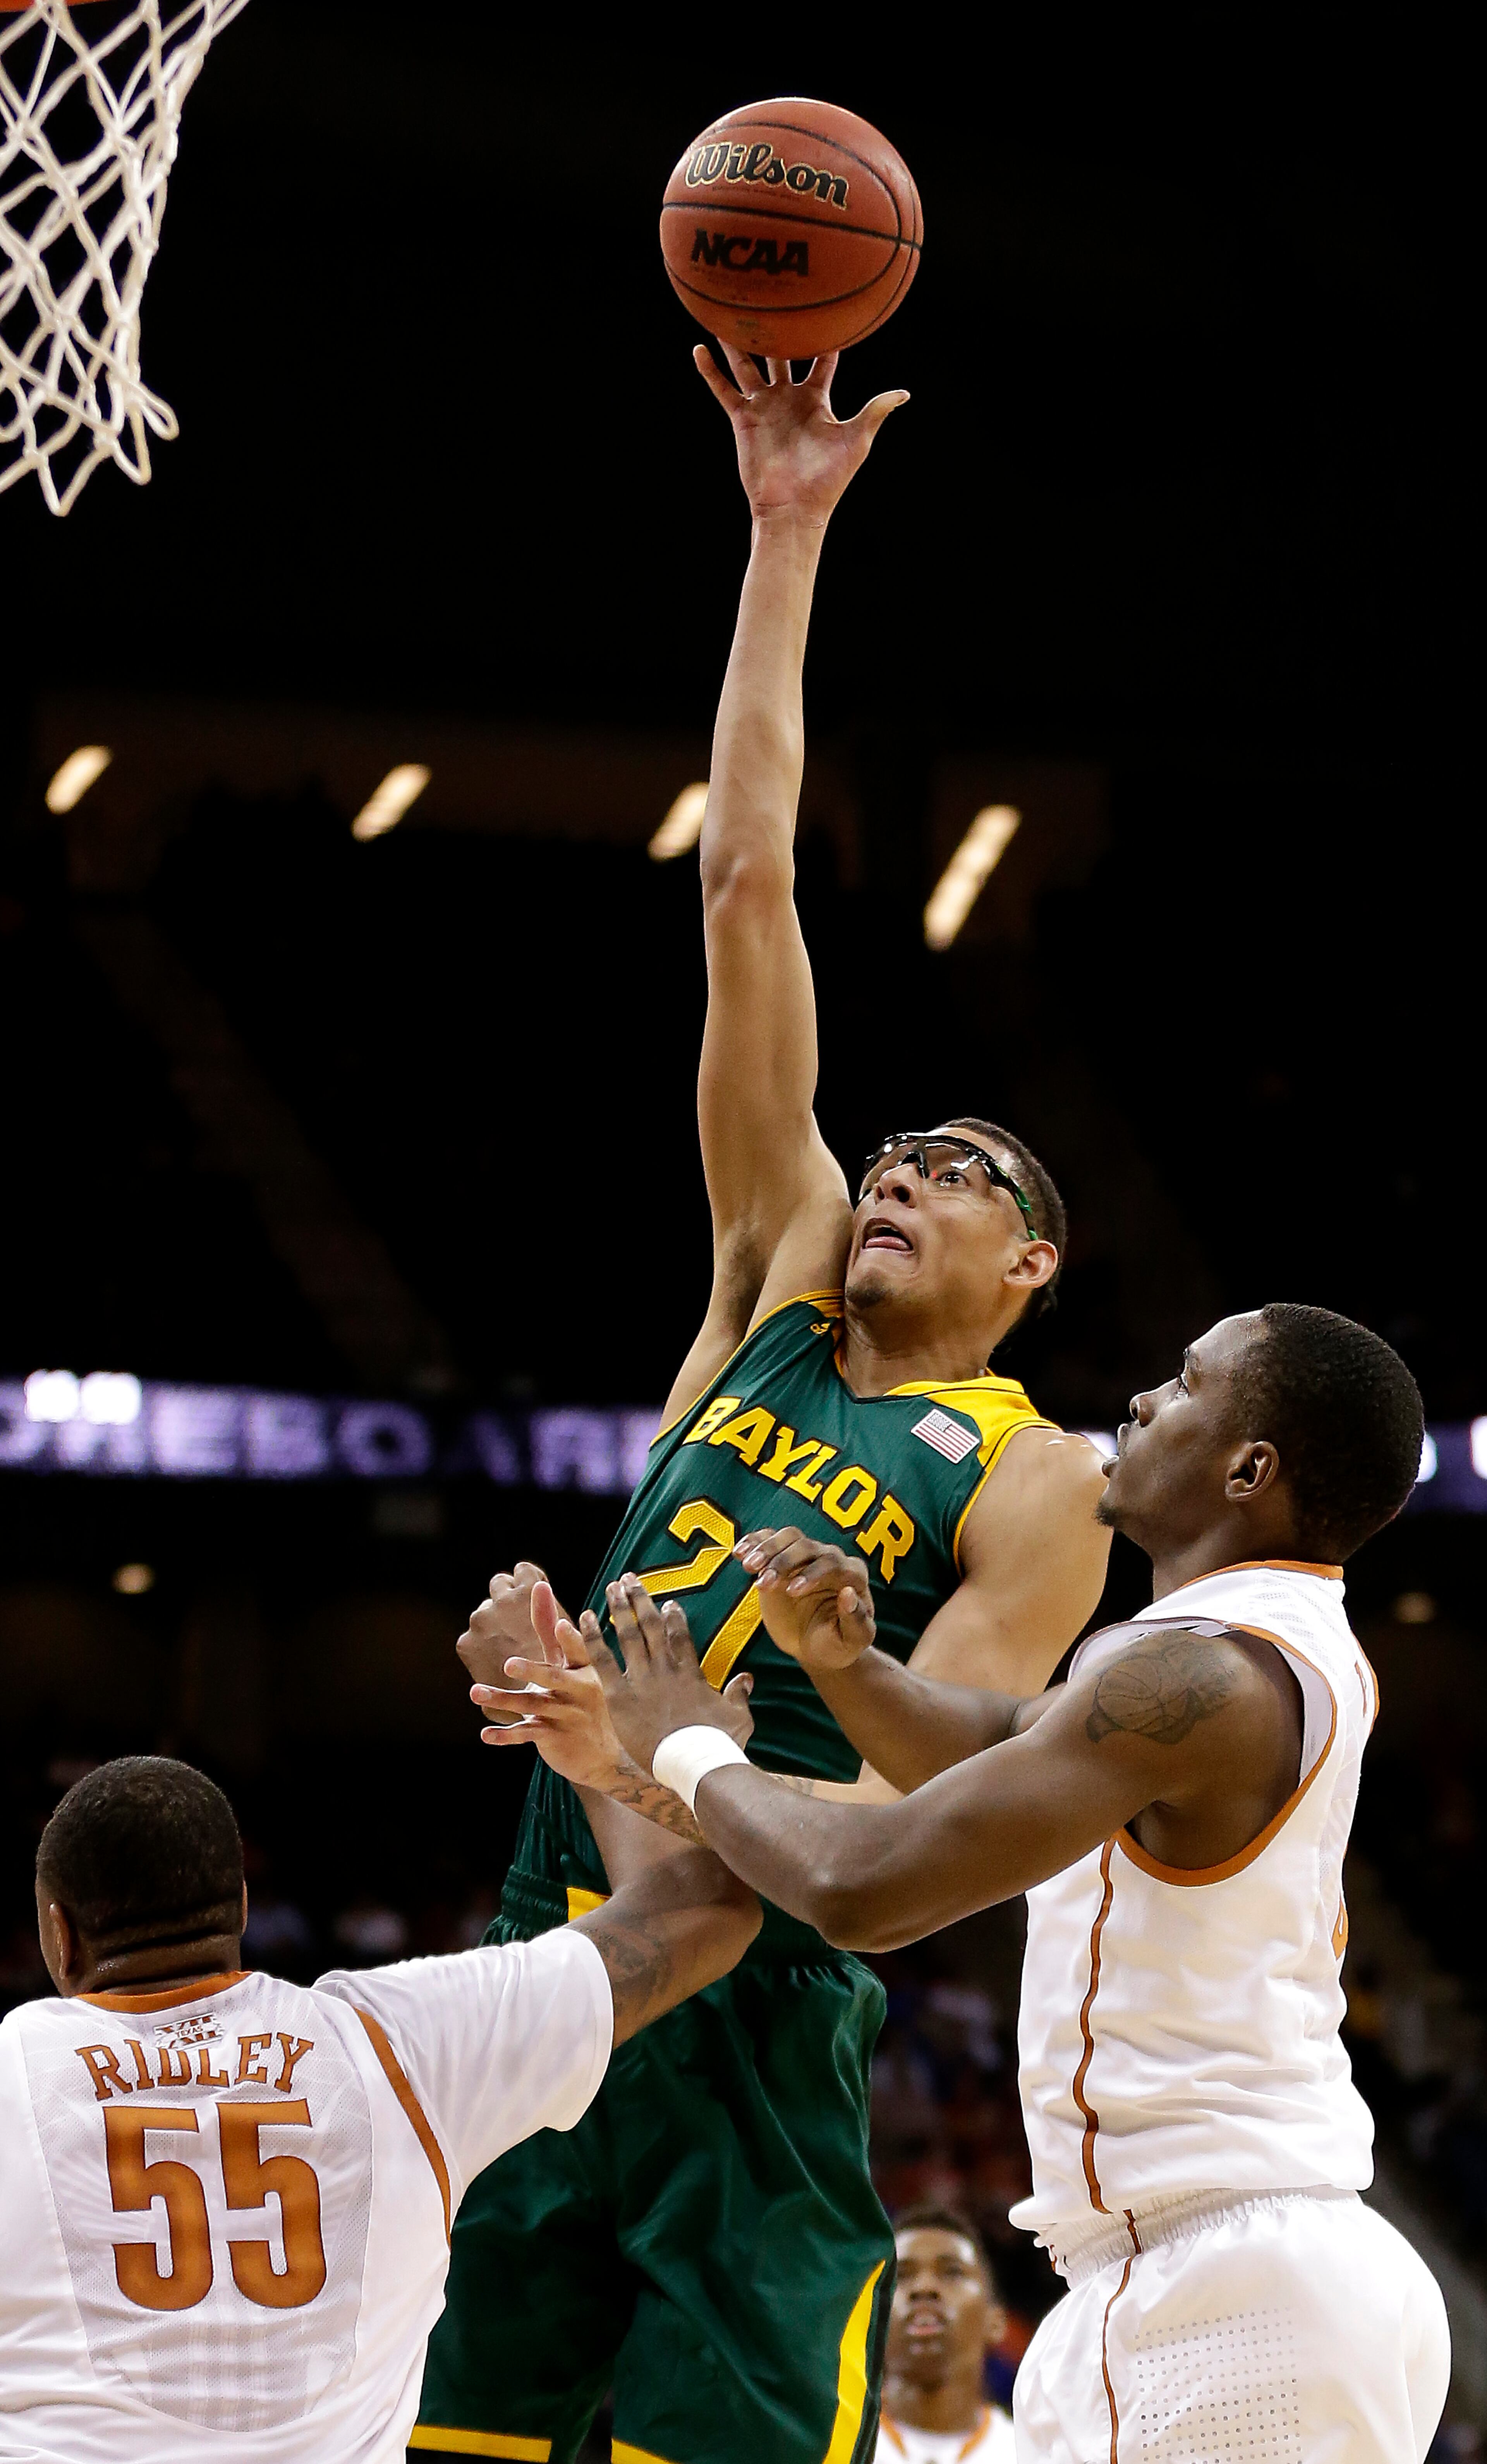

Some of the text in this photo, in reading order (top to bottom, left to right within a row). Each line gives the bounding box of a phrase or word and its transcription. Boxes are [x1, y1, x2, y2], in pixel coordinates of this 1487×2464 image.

[685, 142, 849, 211] Wilson
[691, 228, 809, 276] NCAA
[683, 1396, 915, 1585] BAYLOR
[177, 2025, 203, 2038] TEXAS
[74, 2032, 314, 2101] RIDLEY
[102, 2098, 327, 2311] 55
